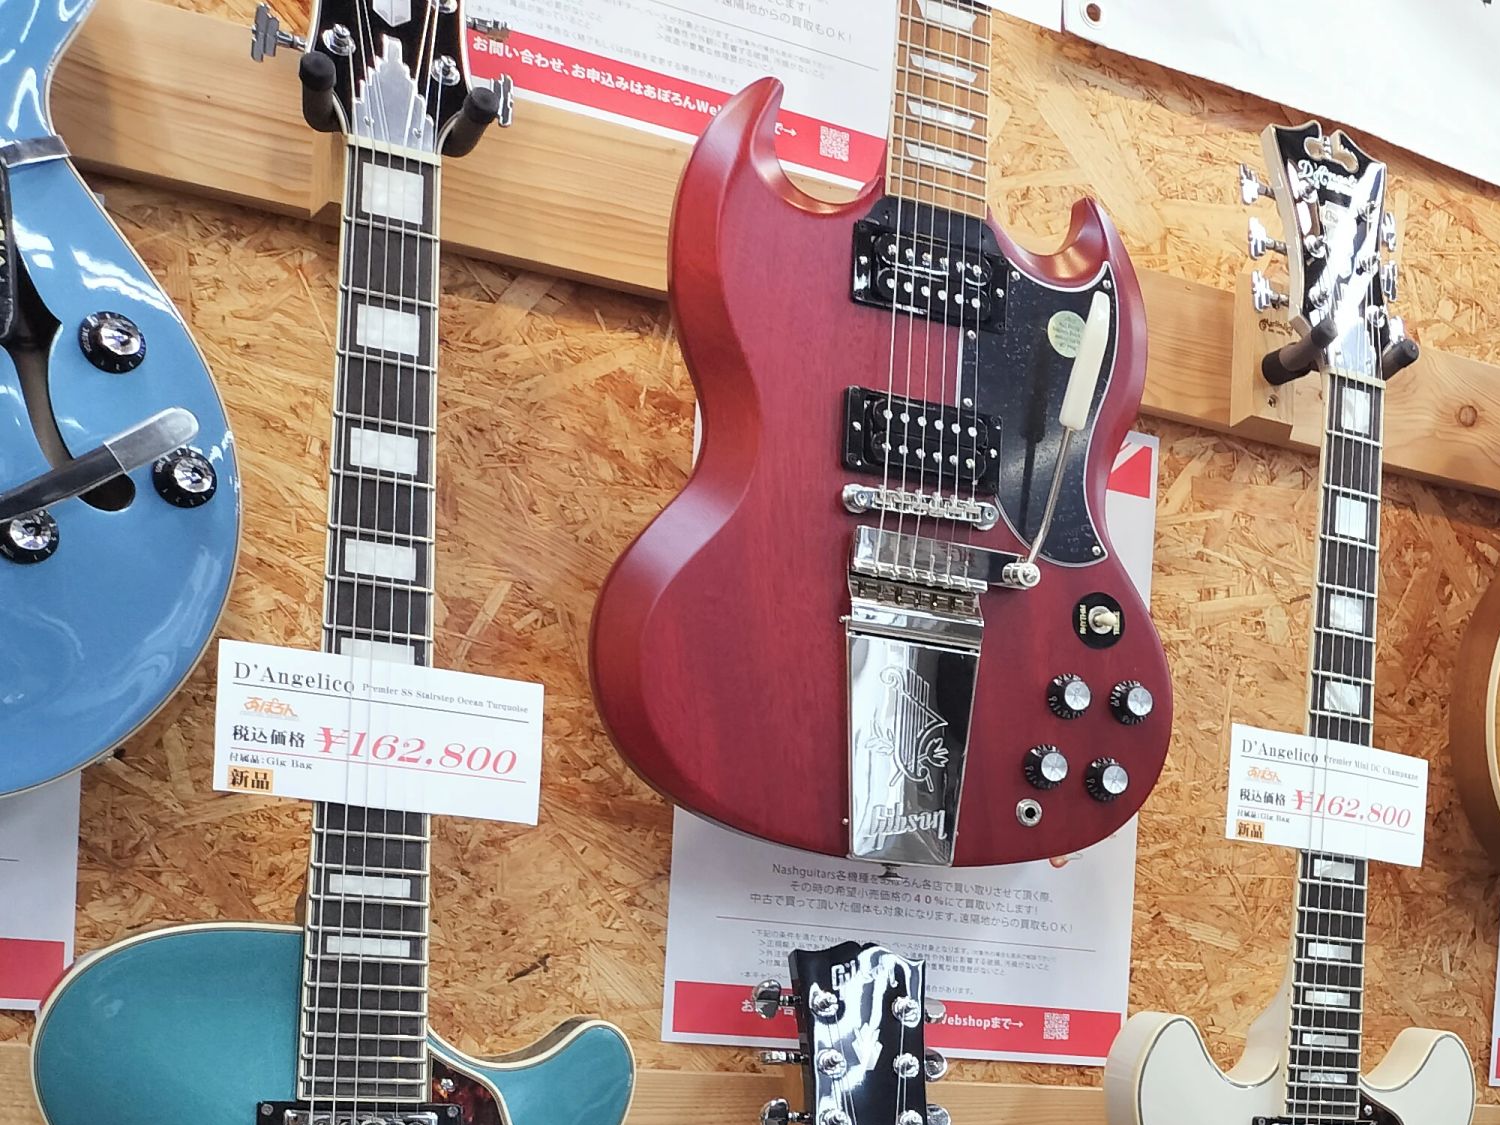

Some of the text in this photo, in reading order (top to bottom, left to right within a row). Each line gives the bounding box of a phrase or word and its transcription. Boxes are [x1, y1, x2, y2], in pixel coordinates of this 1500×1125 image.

[233, 661, 355, 694] D'Angelico
[401, 688, 413, 698] SS
[457, 696, 484, 708] Ocean
[232, 724, 305, 749] 税込価格
[1241, 739, 1318, 764] D'Angelico
[230, 768, 270, 790] 新品
[1240, 788, 1286, 806] 税込価格
[863, 802, 947, 850] Gibson
[1238, 822, 1263, 839] 新品
